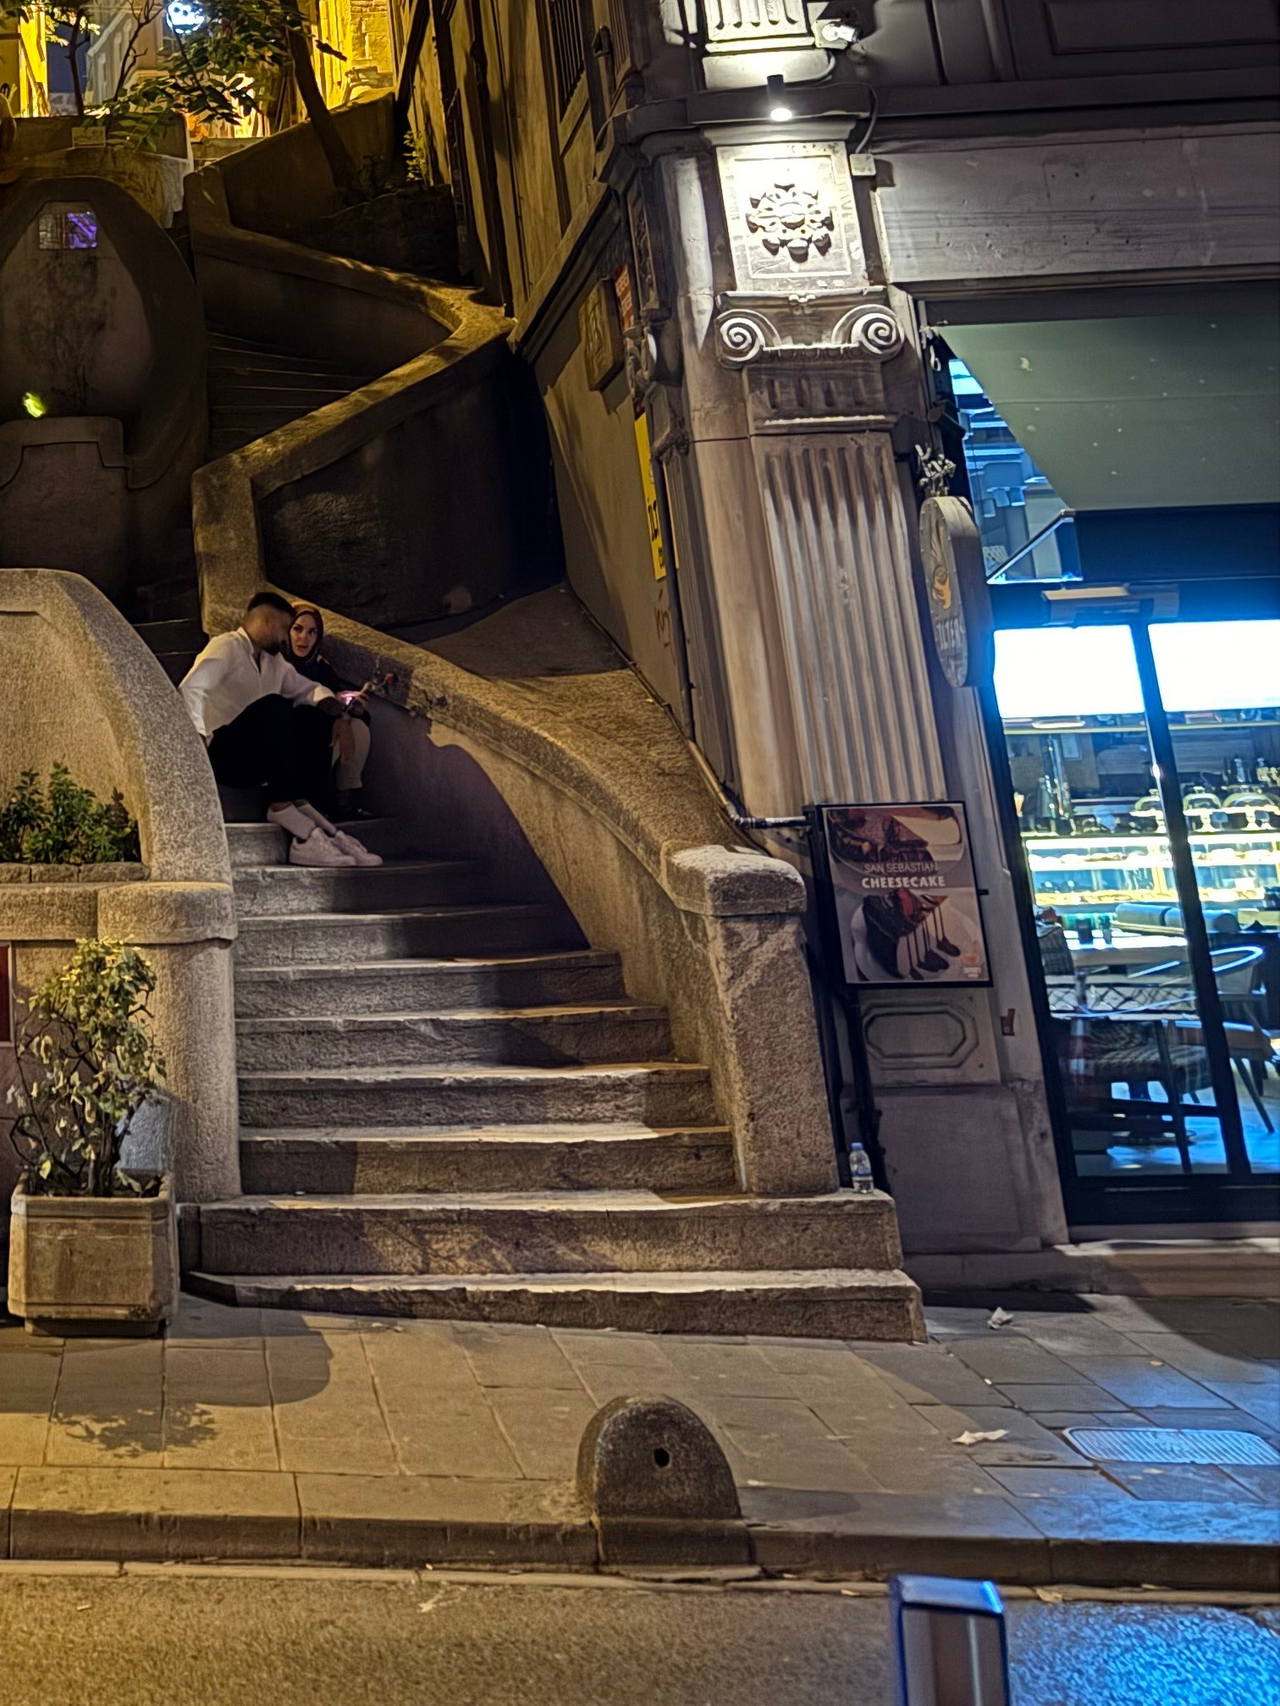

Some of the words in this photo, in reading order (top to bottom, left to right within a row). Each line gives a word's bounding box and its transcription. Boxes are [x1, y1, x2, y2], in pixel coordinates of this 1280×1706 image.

[864, 863, 885, 873] SAN
[886, 862, 938, 873] SEBASTIAN
[861, 876, 946, 888] CHEESECAKE
